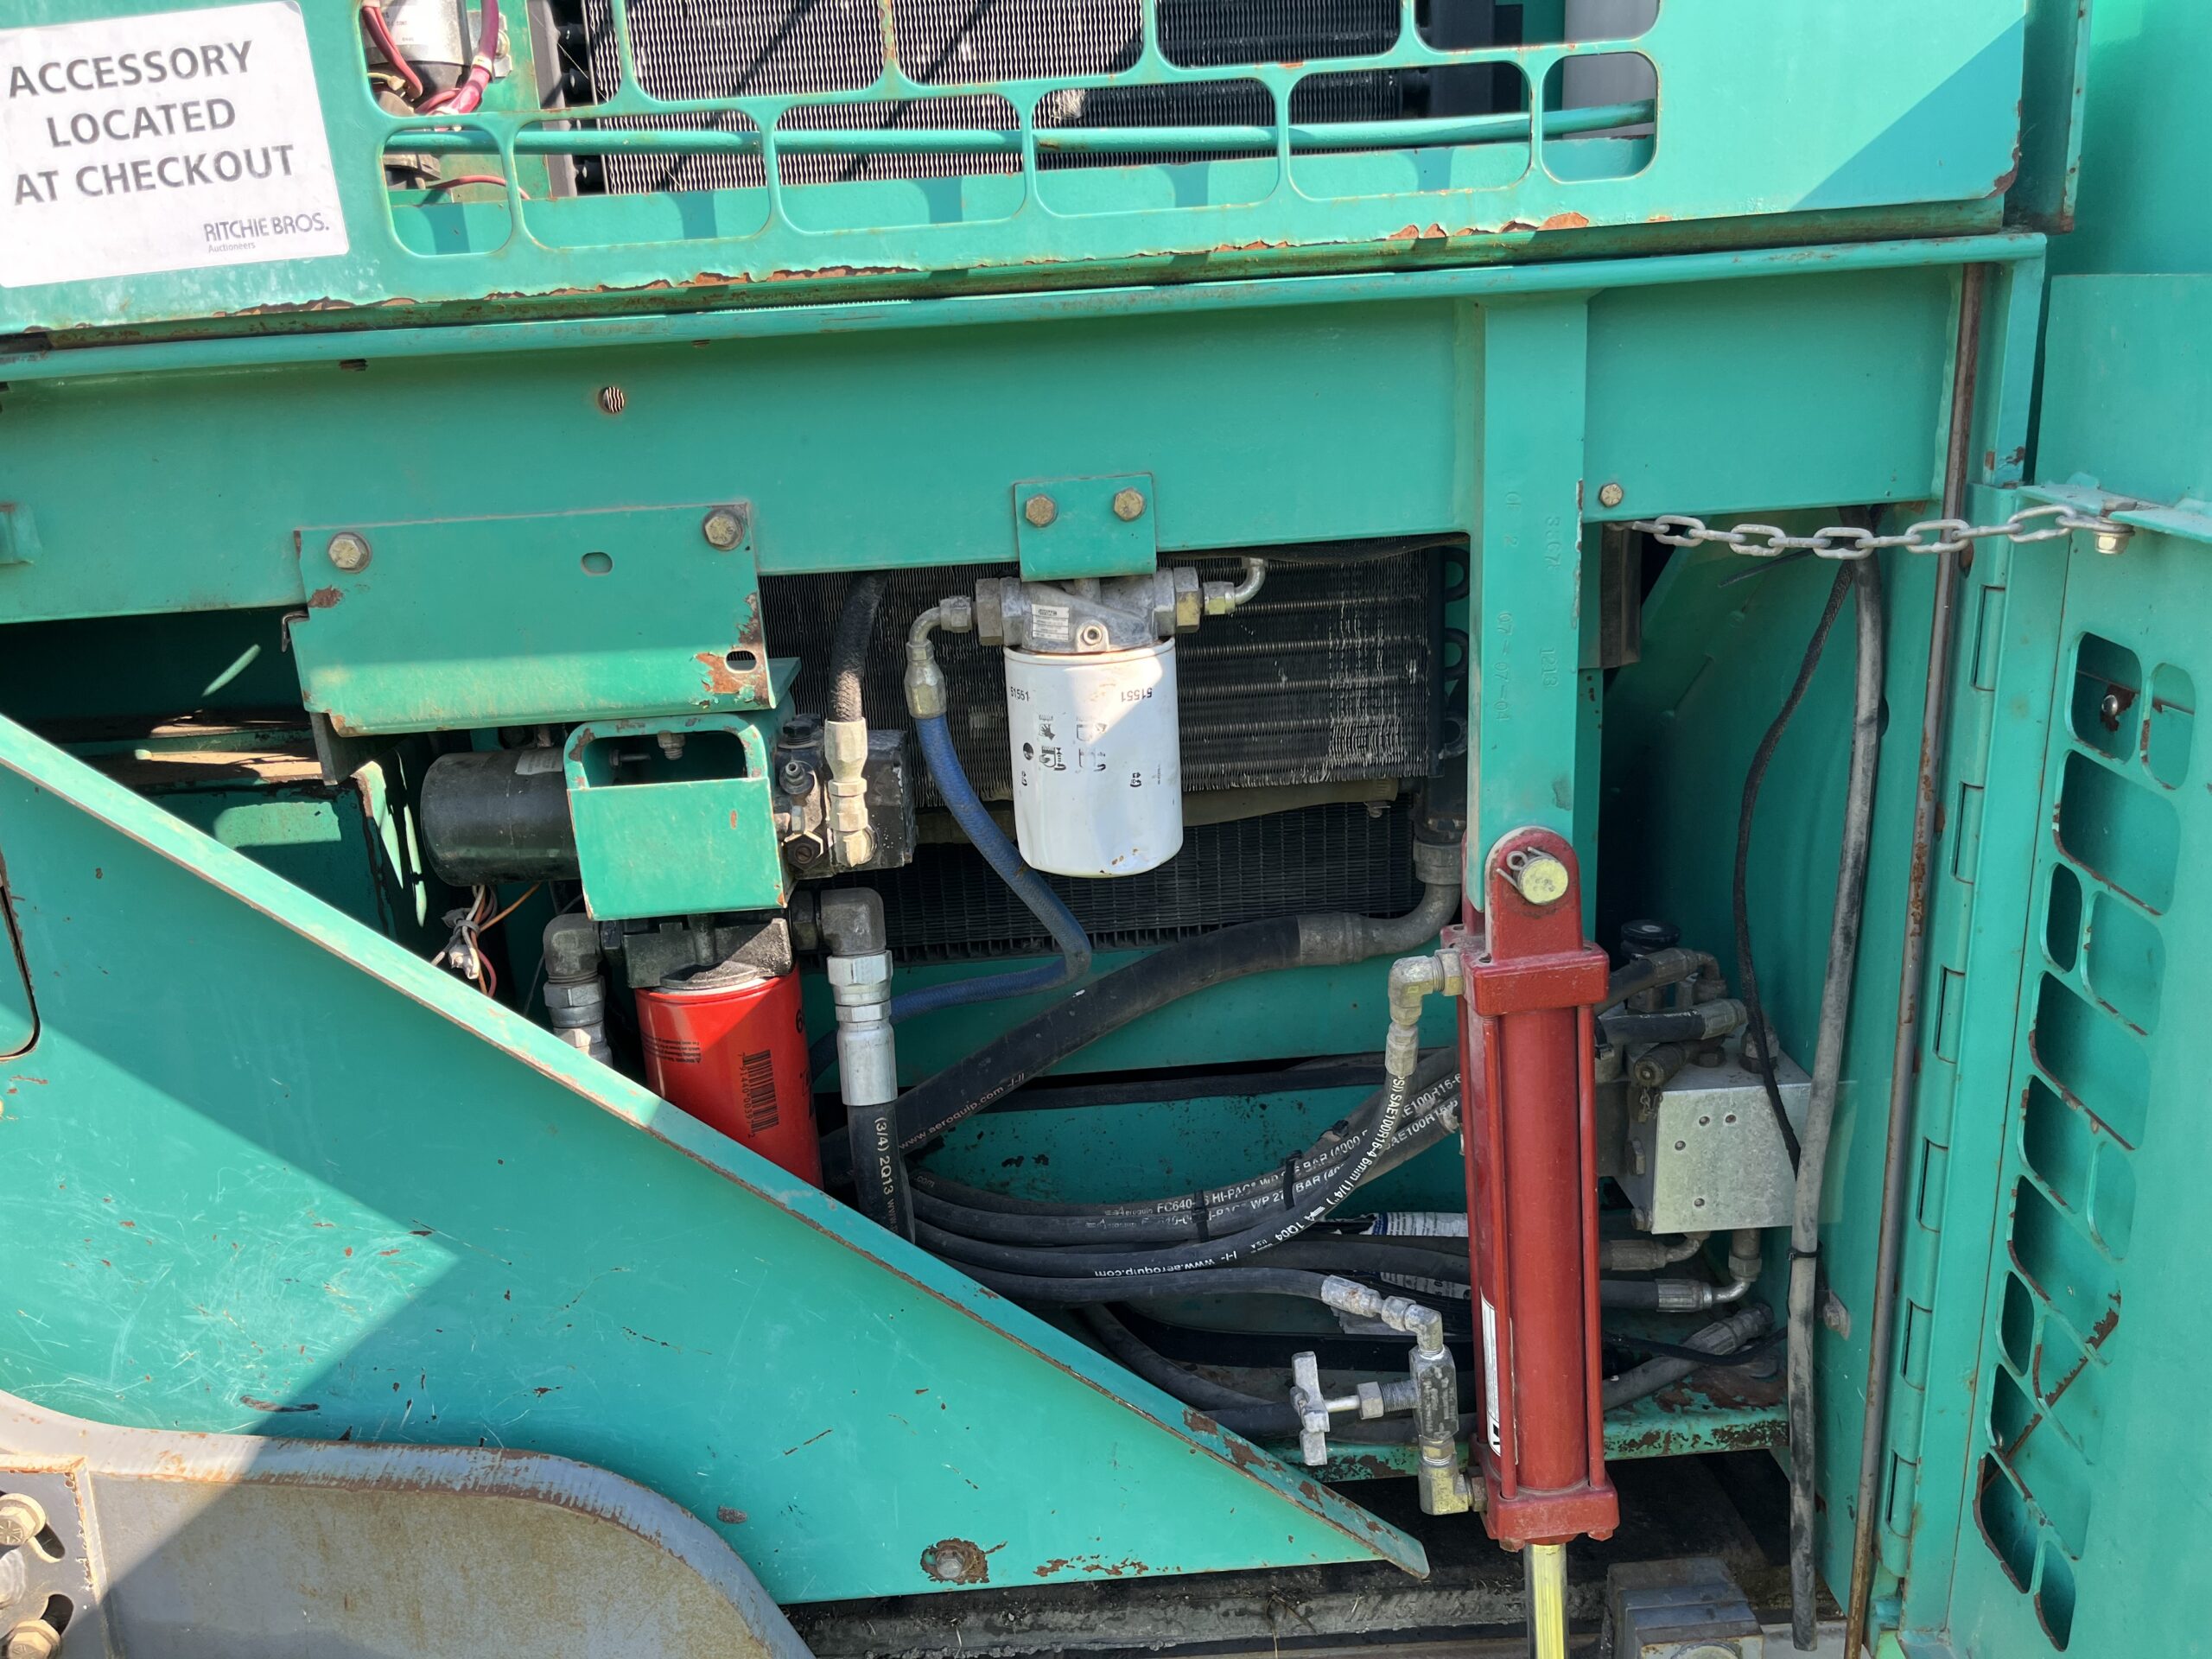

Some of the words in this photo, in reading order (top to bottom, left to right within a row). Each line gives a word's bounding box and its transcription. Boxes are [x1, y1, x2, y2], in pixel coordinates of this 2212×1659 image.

[10, 40, 252, 99] ACCESSORY
[47, 98, 236, 148] LOCATED
[15, 169, 60, 206] AT
[75, 144, 295, 198] CHECKOUT
[203, 217, 270, 242] RITCHIE
[271, 213, 330, 235] BROS.
[208, 242, 256, 254] Auctioneers
[1010, 686, 1030, 702] 51551
[1121, 687, 1153, 703] 51551
[1392, 1075, 1405, 1092] SI)
[1401, 1073, 1461, 1118] E100R16-6
[874, 1116, 890, 1152] (3/4)
[899, 1086, 1004, 1150] www.aeroquip.com
[1366, 1093, 1402, 1157] SAE100R16-4
[880, 1155, 894, 1195] 2Q13
[1350, 1157, 1373, 1181] 6mm
[1157, 1195, 1210, 1213] FC640-6
[1250, 1196, 1269, 1210] WP
[1273, 1190, 1285, 1203] 27
[1296, 1175, 1320, 1192] BAR
[1274, 1222, 1305, 1241] 1Q04
[1095, 1258, 1216, 1278] www.aeroquip.com
